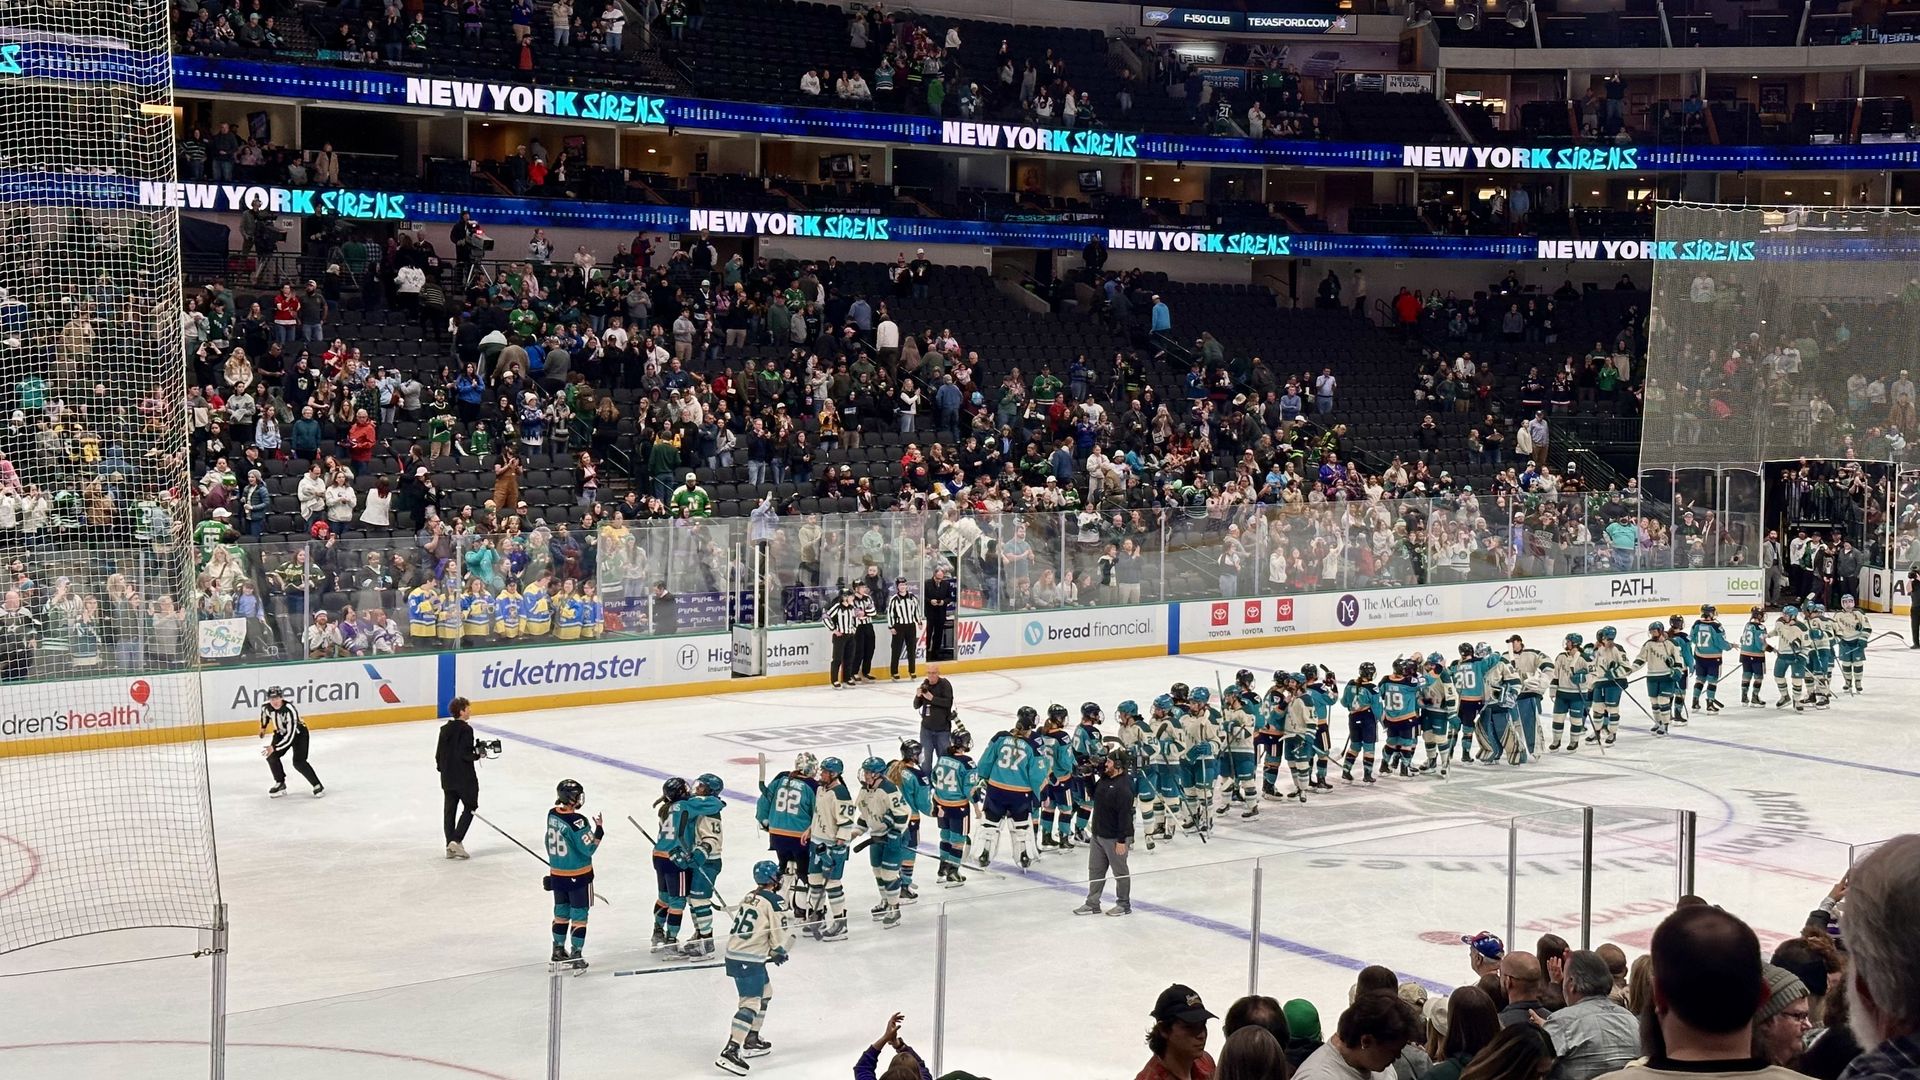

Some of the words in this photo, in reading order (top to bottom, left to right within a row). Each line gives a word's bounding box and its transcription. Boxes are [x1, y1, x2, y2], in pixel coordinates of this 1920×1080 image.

[1184, 14, 1206, 23] F-150
[1207, 16, 1231, 25] CLUB
[1248, 18, 1329, 28] TEXASFORD.COM
[407, 78, 483, 109] NEW
[488, 85, 579, 116] YORK
[943, 121, 999, 146] NEW
[1002, 126, 1072, 152] YORK
[1404, 146, 1468, 168] NEW
[1472, 147, 1553, 169] YORK
[139, 181, 218, 208] NEW
[220, 185, 316, 214] YORK
[690, 210, 749, 233] NEW
[751, 212, 823, 237] YORK
[1109, 229, 1155, 250] NEW
[1158, 231, 1226, 253] YORK
[1538, 240, 1598, 259] NEW
[1602, 240, 1678, 261] YORK
[1511, 585, 1537, 599] DMG
[1612, 578, 1654, 598] PATH
[1728, 577, 1763, 591] ideal
[1363, 598, 1377, 611] The
[1381, 595, 1424, 610] McCauley
[1426, 594, 1440, 606] Co.
[1048, 623, 1091, 642] bread
[1698, 632, 1711, 647] 17
[482, 655, 648, 690] ticketmaster
[1454, 671, 1476, 689] 20
[1385, 693, 1404, 711] 19
[998, 746, 1027, 771] 37
[776, 788, 802, 815] 82
[1702, 788, 1823, 855] American
[1306, 852, 1677, 877] Airlines
